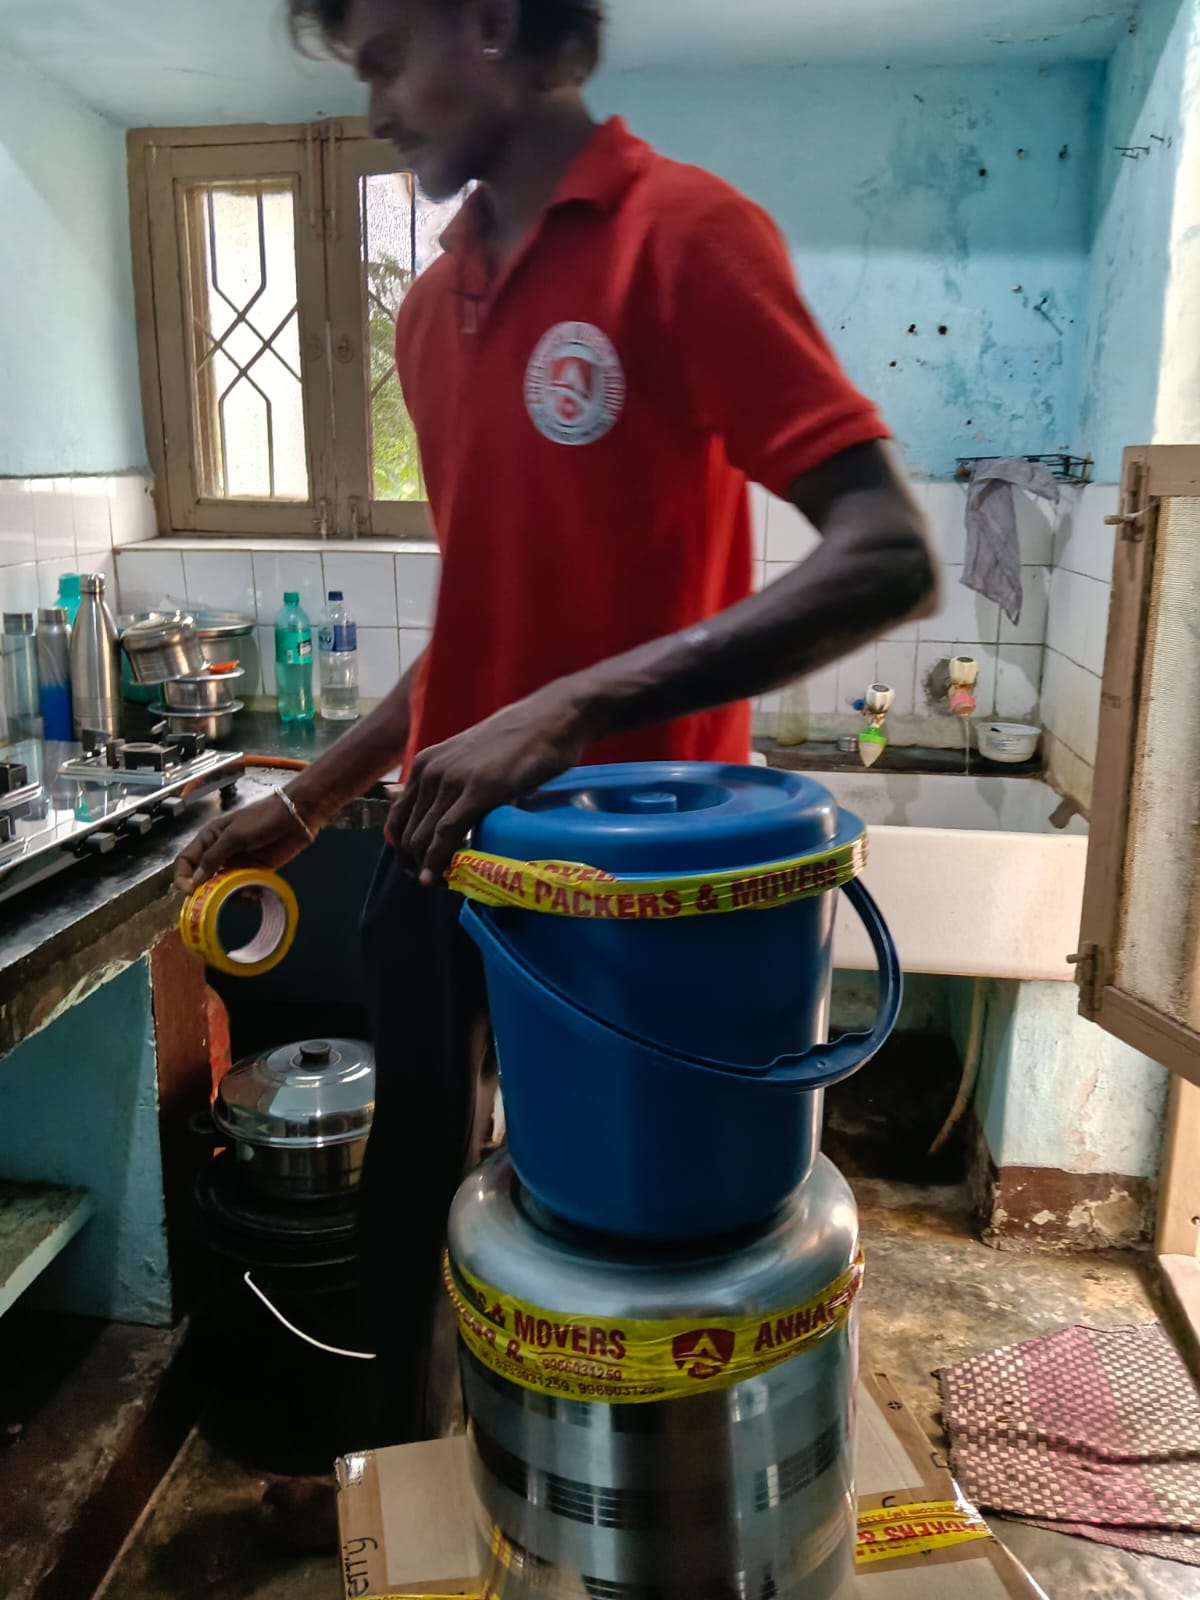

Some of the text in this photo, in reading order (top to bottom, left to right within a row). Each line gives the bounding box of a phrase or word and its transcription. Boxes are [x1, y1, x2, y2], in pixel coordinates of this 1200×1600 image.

[534, 878, 682, 918] PACKERS
[696, 883, 719, 911] &
[731, 858, 838, 908] MOVERS
[514, 1308, 627, 1360] MOVERS
